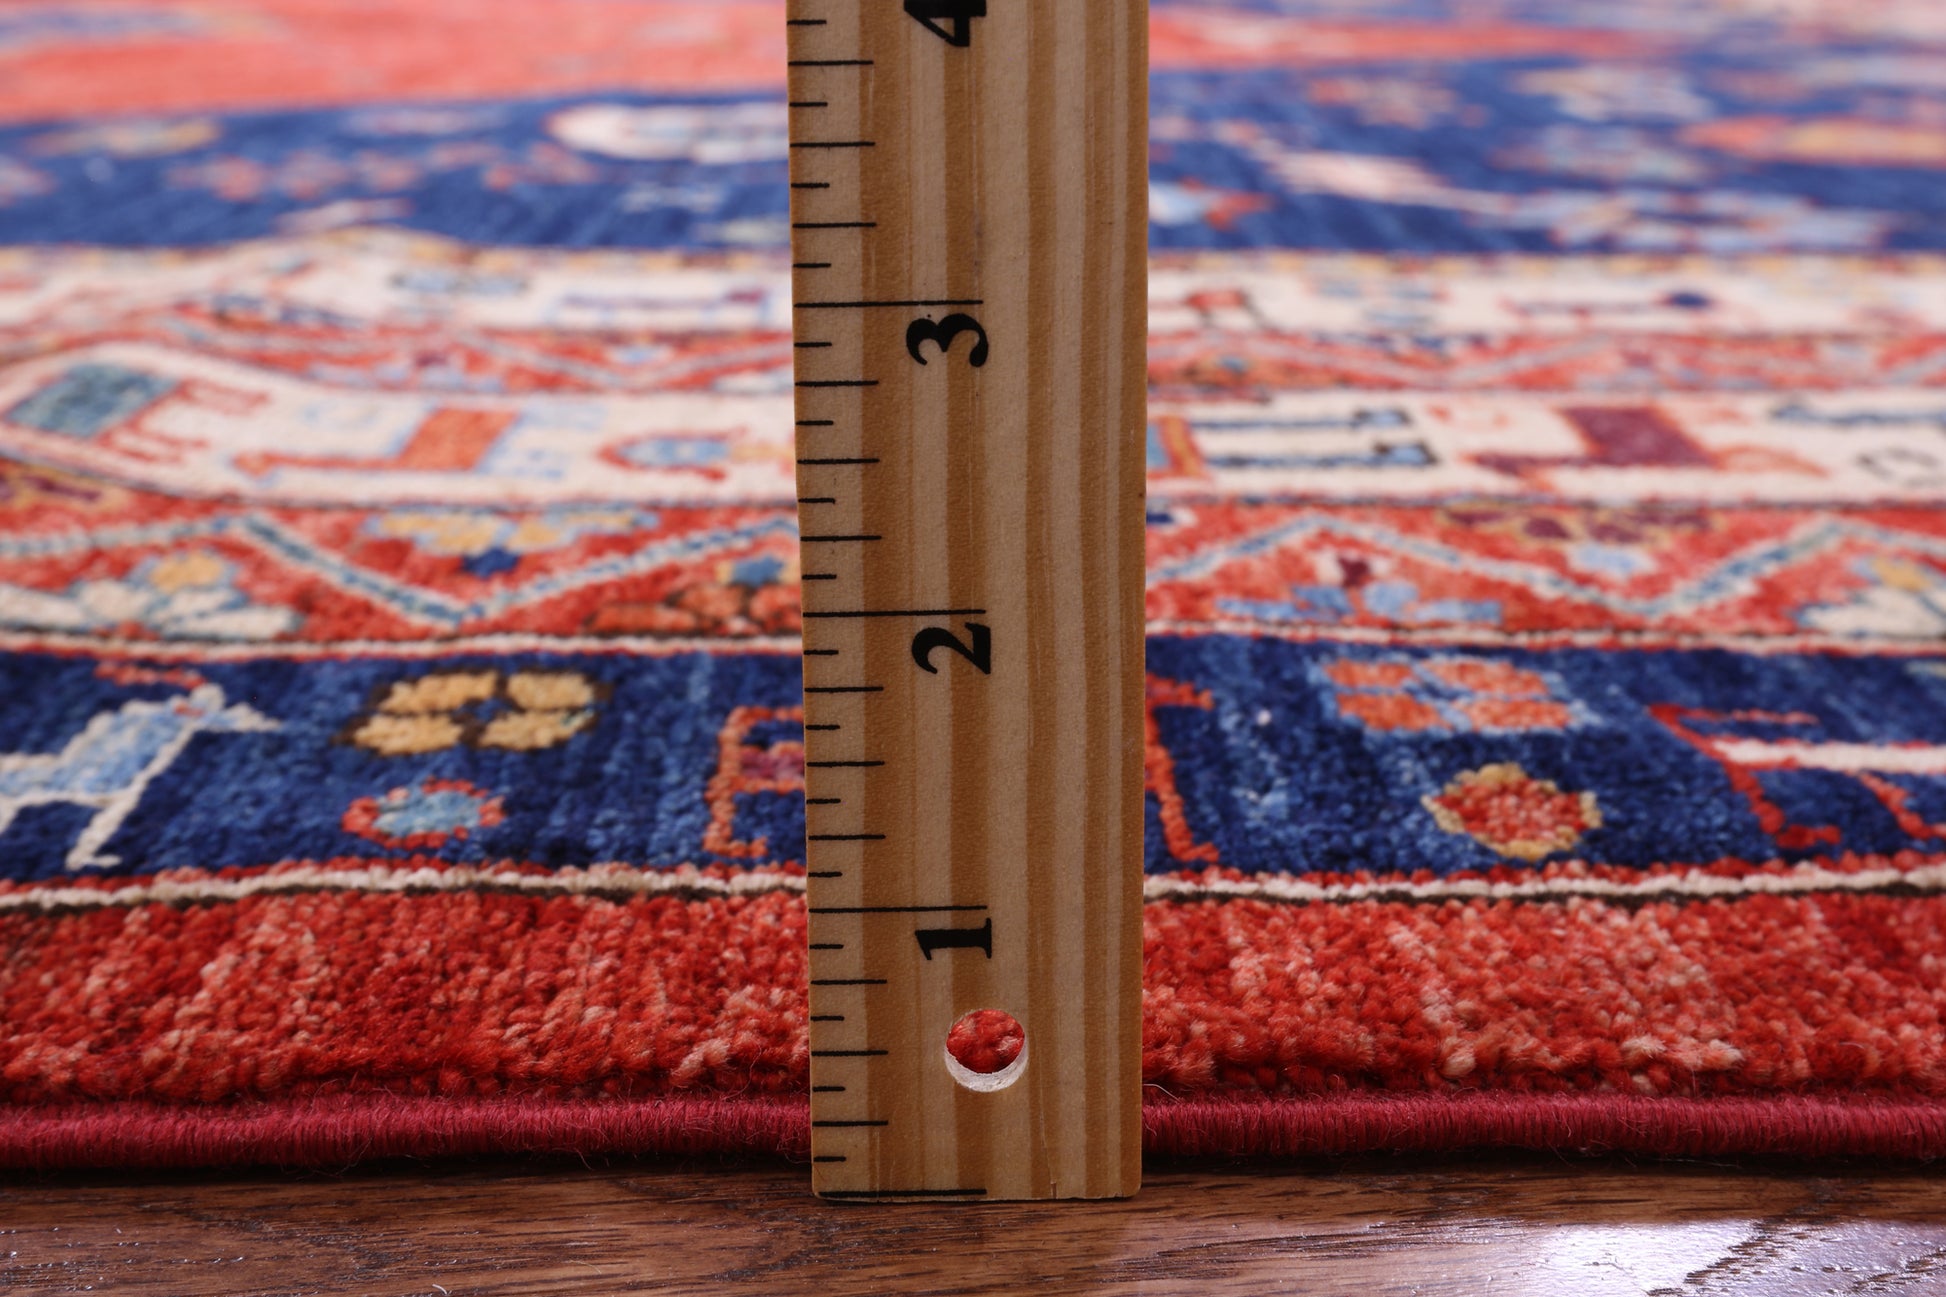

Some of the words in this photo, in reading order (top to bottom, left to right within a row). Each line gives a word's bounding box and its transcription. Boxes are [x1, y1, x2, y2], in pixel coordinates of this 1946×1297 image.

[903, 0, 987, 47] 4
[906, 313, 989, 367] 3
[911, 622, 992, 674] 2
[915, 917, 992, 961] 1
